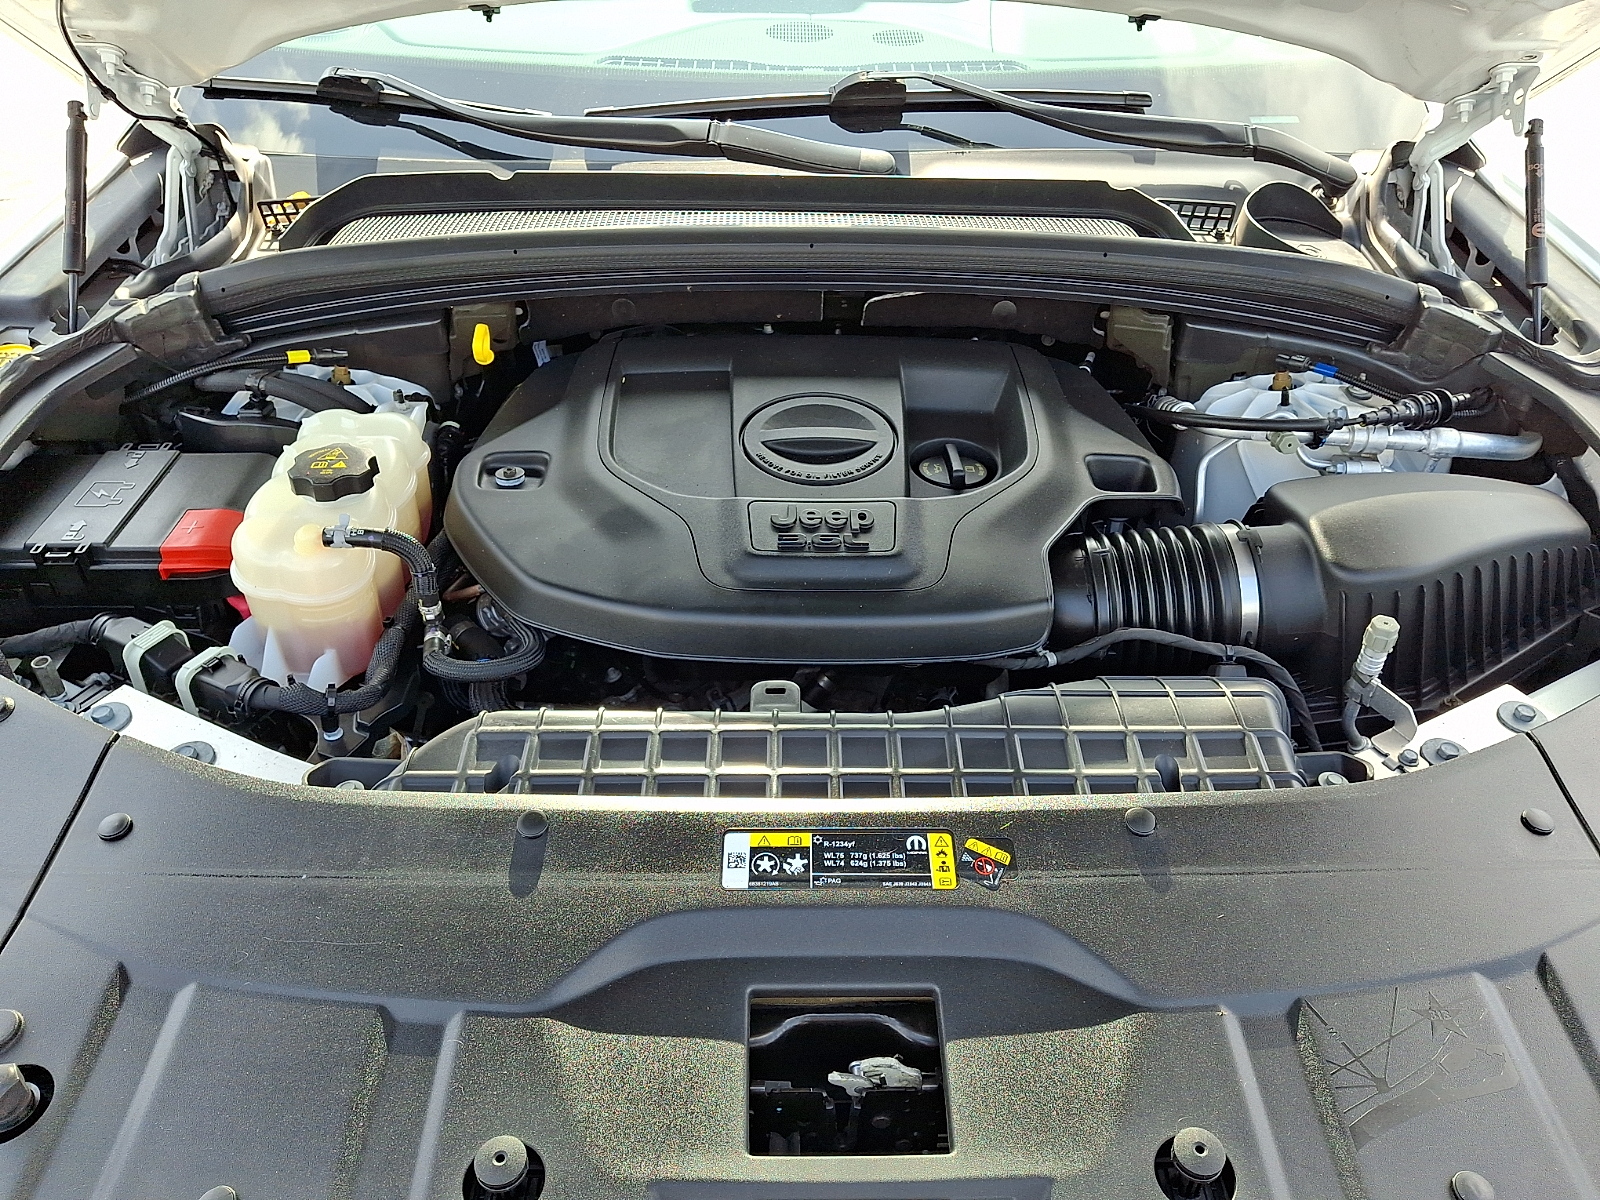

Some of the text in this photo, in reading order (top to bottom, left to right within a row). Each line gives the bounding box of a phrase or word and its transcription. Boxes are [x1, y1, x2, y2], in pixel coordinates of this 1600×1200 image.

[755, 452, 784, 472] REMOVE
[784, 468, 803, 478] FOR
[823, 470, 854, 480] FILTER
[854, 453, 883, 472] SERVICE
[770, 504, 875, 534] Jeep
[777, 532, 869, 551] 3.6L
[823, 840, 855, 849] R-1234yf
[850, 852, 867, 860] 737g
[869, 852, 890, 860] (1.625
[892, 852, 906, 860] lbs)
[850, 860, 867, 868] 624g
[869, 860, 891, 868] (1.375
[892, 860, 907, 868] lbs)
